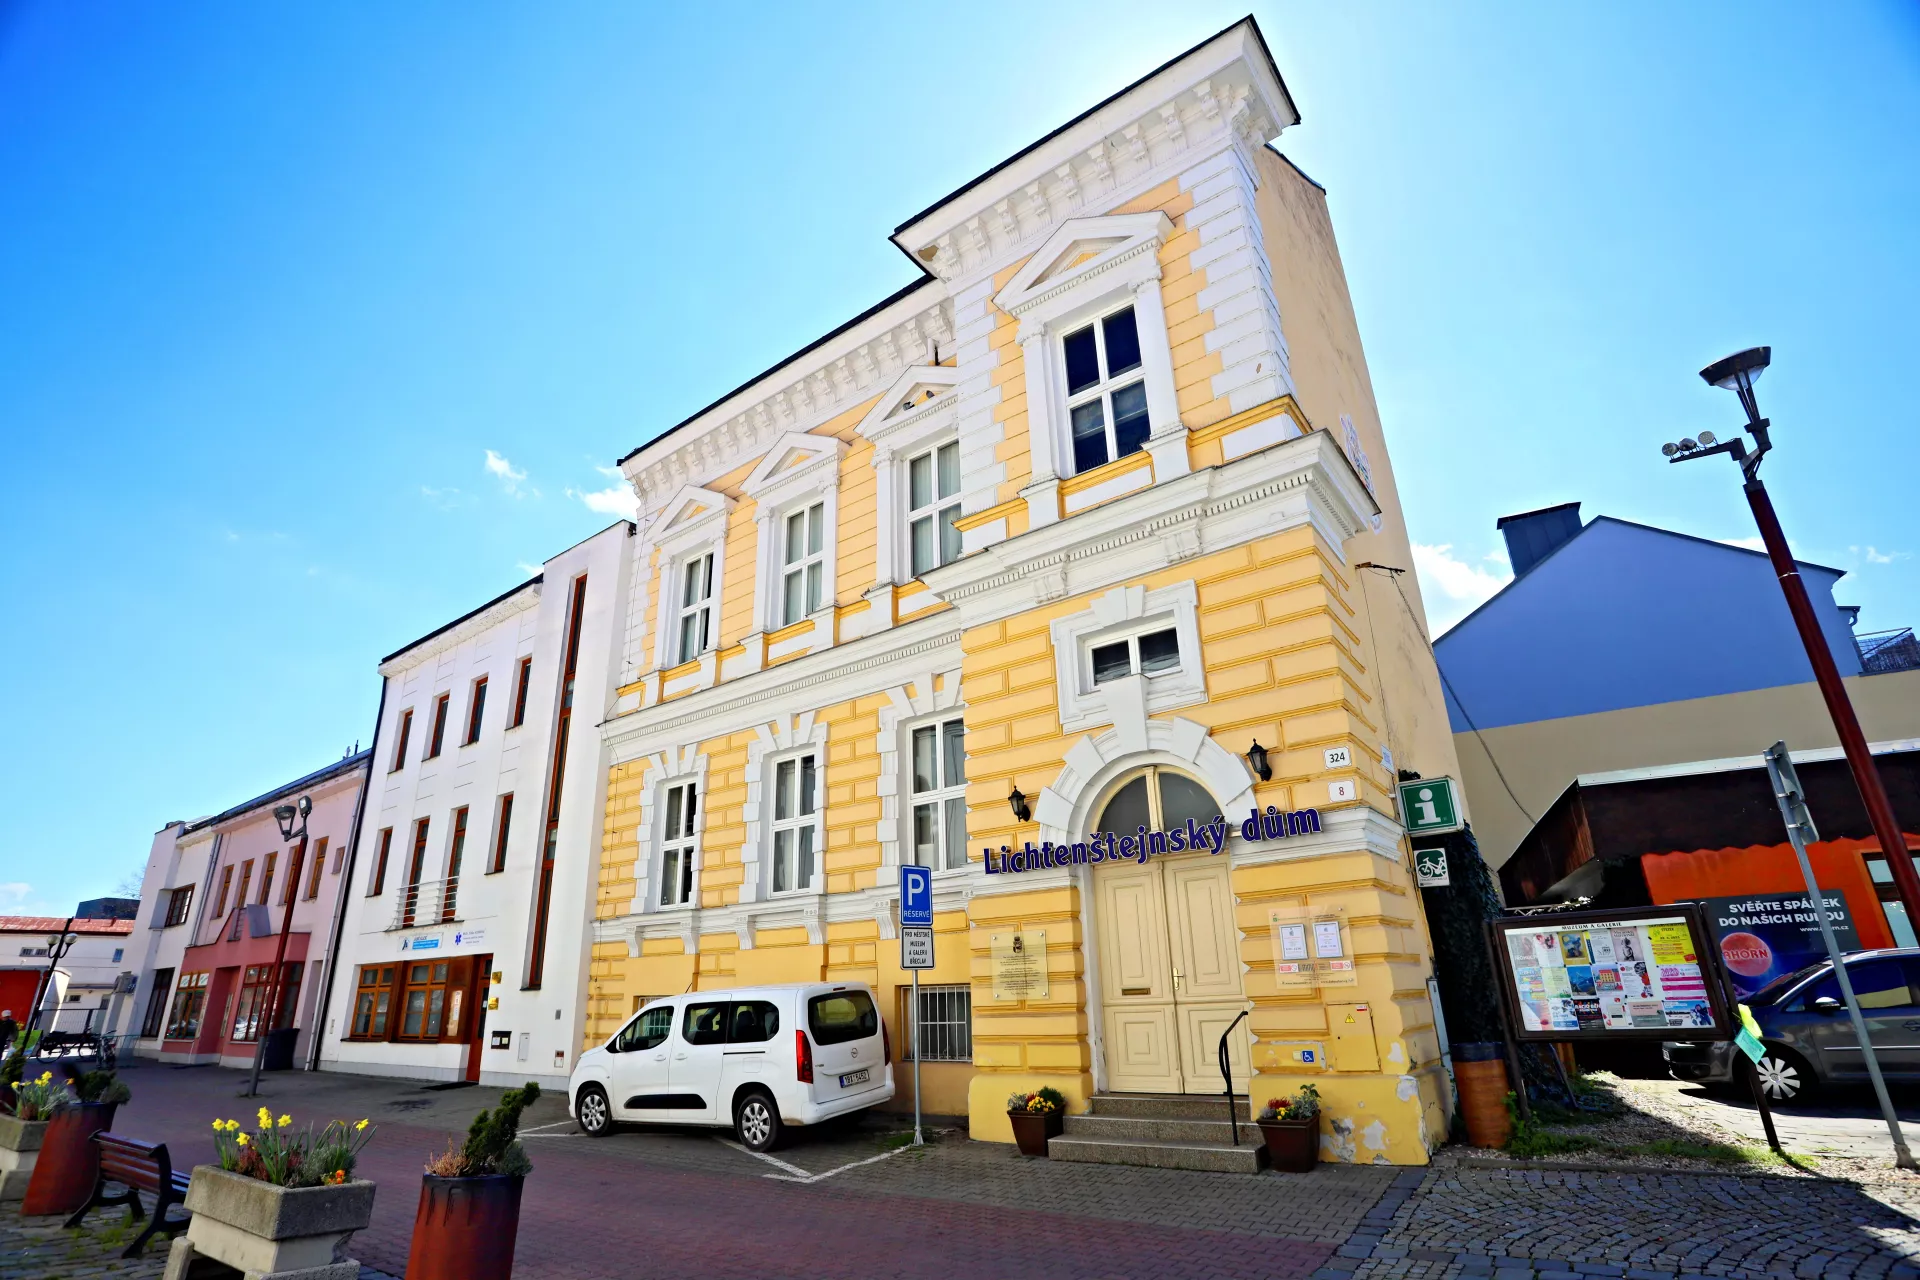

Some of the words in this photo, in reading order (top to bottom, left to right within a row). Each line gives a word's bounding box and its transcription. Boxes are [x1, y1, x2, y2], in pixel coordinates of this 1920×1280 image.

[1329, 752, 1345, 763] 324
[1338, 786, 1345, 796] 8
[983, 815, 1227, 875] Lichtenštejnský
[1241, 805, 1322, 842] dům
[907, 873, 924, 906] P
[1729, 901, 1782, 913] SVĚŘTE
[1783, 897, 1841, 911] SPÁEK
[903, 909, 930, 918] RÉSERVÉ
[1719, 917, 1739, 927] DO
[1740, 913, 1793, 926] NAŠICH
[1723, 949, 1768, 960] AHORN
